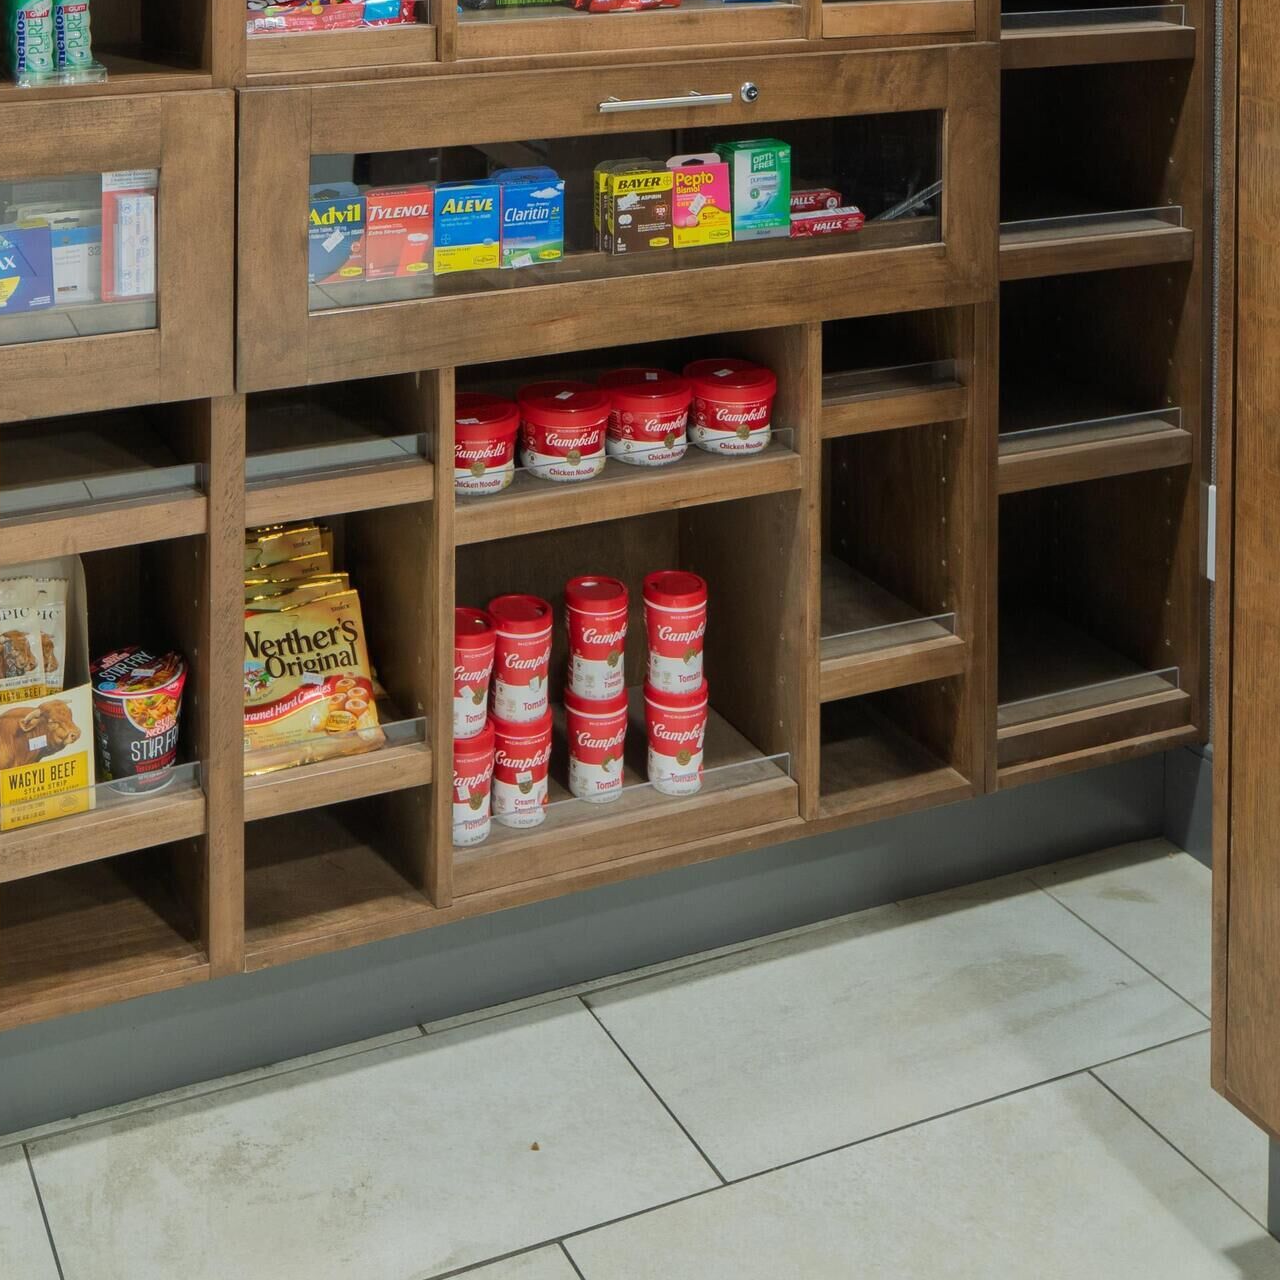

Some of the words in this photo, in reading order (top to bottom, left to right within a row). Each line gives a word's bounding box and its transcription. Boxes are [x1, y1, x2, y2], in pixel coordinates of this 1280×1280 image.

[28, 19, 43, 54] PURE
[56, 6, 65, 70] mentos
[67, 14, 82, 48] PURE
[17, 11, 25, 72] mentos
[753, 160, 774, 171] FREE
[618, 176, 661, 190] BAYER
[676, 173, 714, 189] Pepto
[676, 185, 701, 194] Bismol
[310, 204, 361, 225] Advil
[368, 204, 429, 221] TYLENOL
[442, 198, 493, 214] ALEVE
[504, 207, 549, 222] Claritin
[813, 221, 842, 232] HALLS
[716, 404, 768, 424] Campbell's
[545, 430, 599, 449] Campbell's
[720, 442, 743, 451] Chicken
[744, 441, 763, 451] Noodle
[549, 468, 575, 477] Chicken
[575, 466, 595, 476] Noodle
[265, 642, 359, 678] Original
[679, 673, 701, 683] Tomato
[275, 698, 298, 715] Hard
[130, 737, 164, 762] STIR
[9, 769, 45, 790] WAGYU
[50, 760, 77, 778] BEEF
[23, 784, 45, 795] STEAK
[48, 780, 67, 790] STRIP
